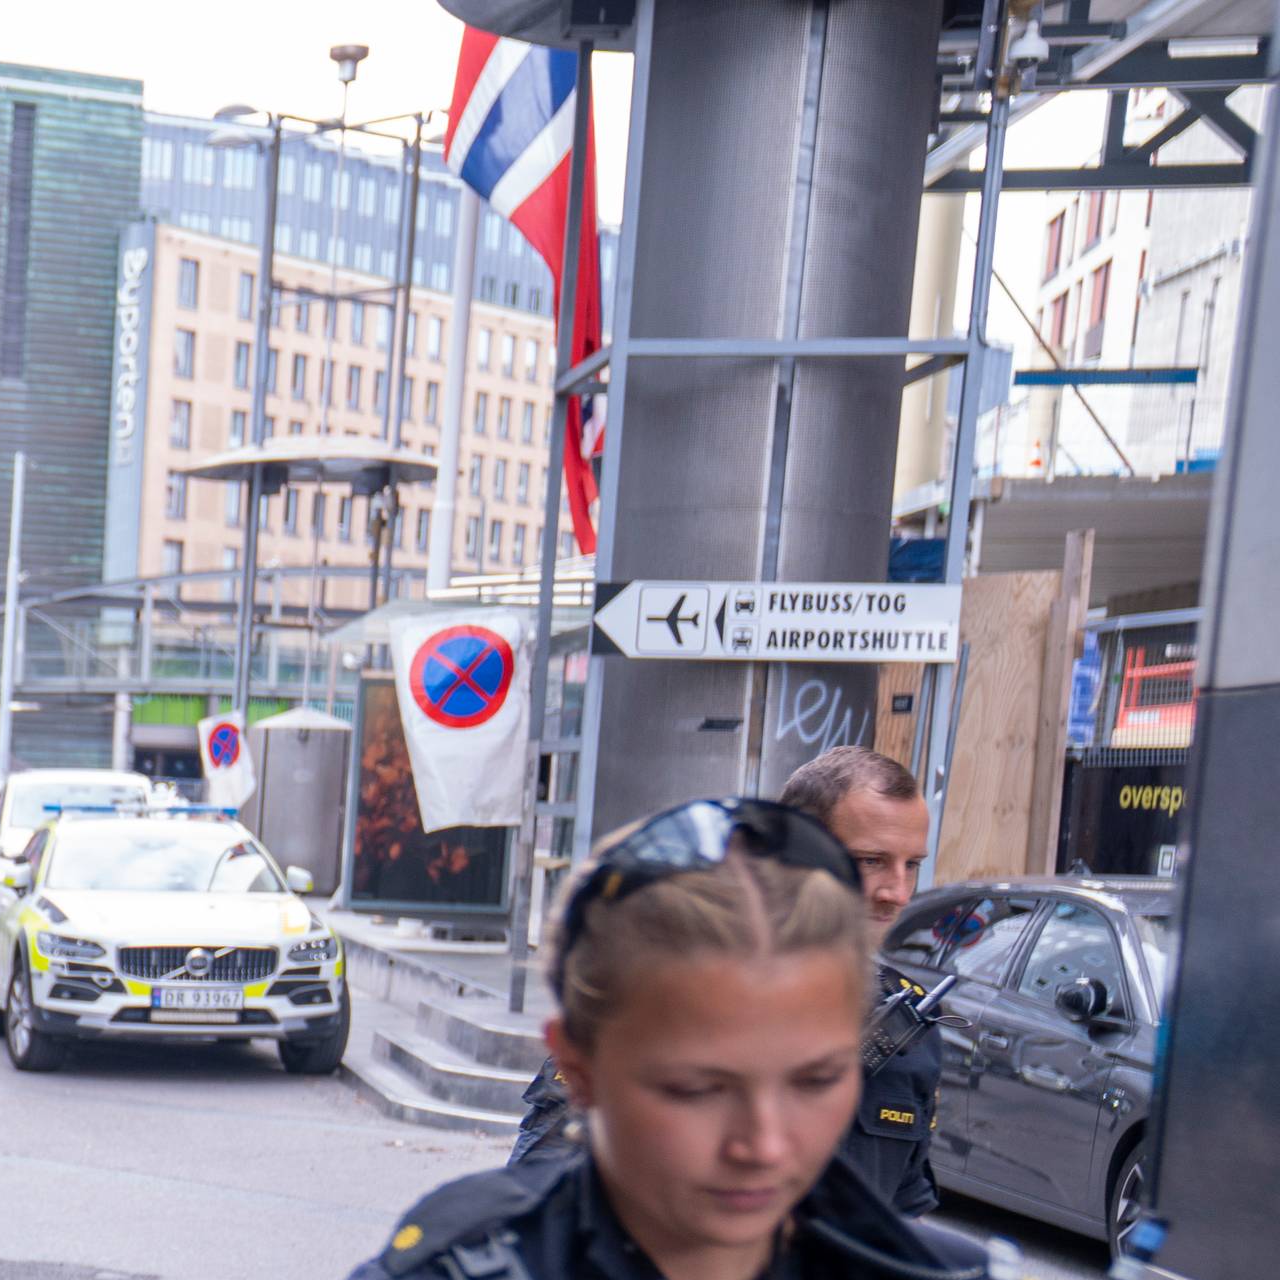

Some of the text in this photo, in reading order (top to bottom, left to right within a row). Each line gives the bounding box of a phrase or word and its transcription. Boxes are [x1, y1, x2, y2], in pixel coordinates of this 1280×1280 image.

[768, 592, 907, 616] FLYBUSS/TOG
[766, 630, 948, 651] AIRPORTSHUTTLE
[880, 1109, 915, 1124] POLITI
